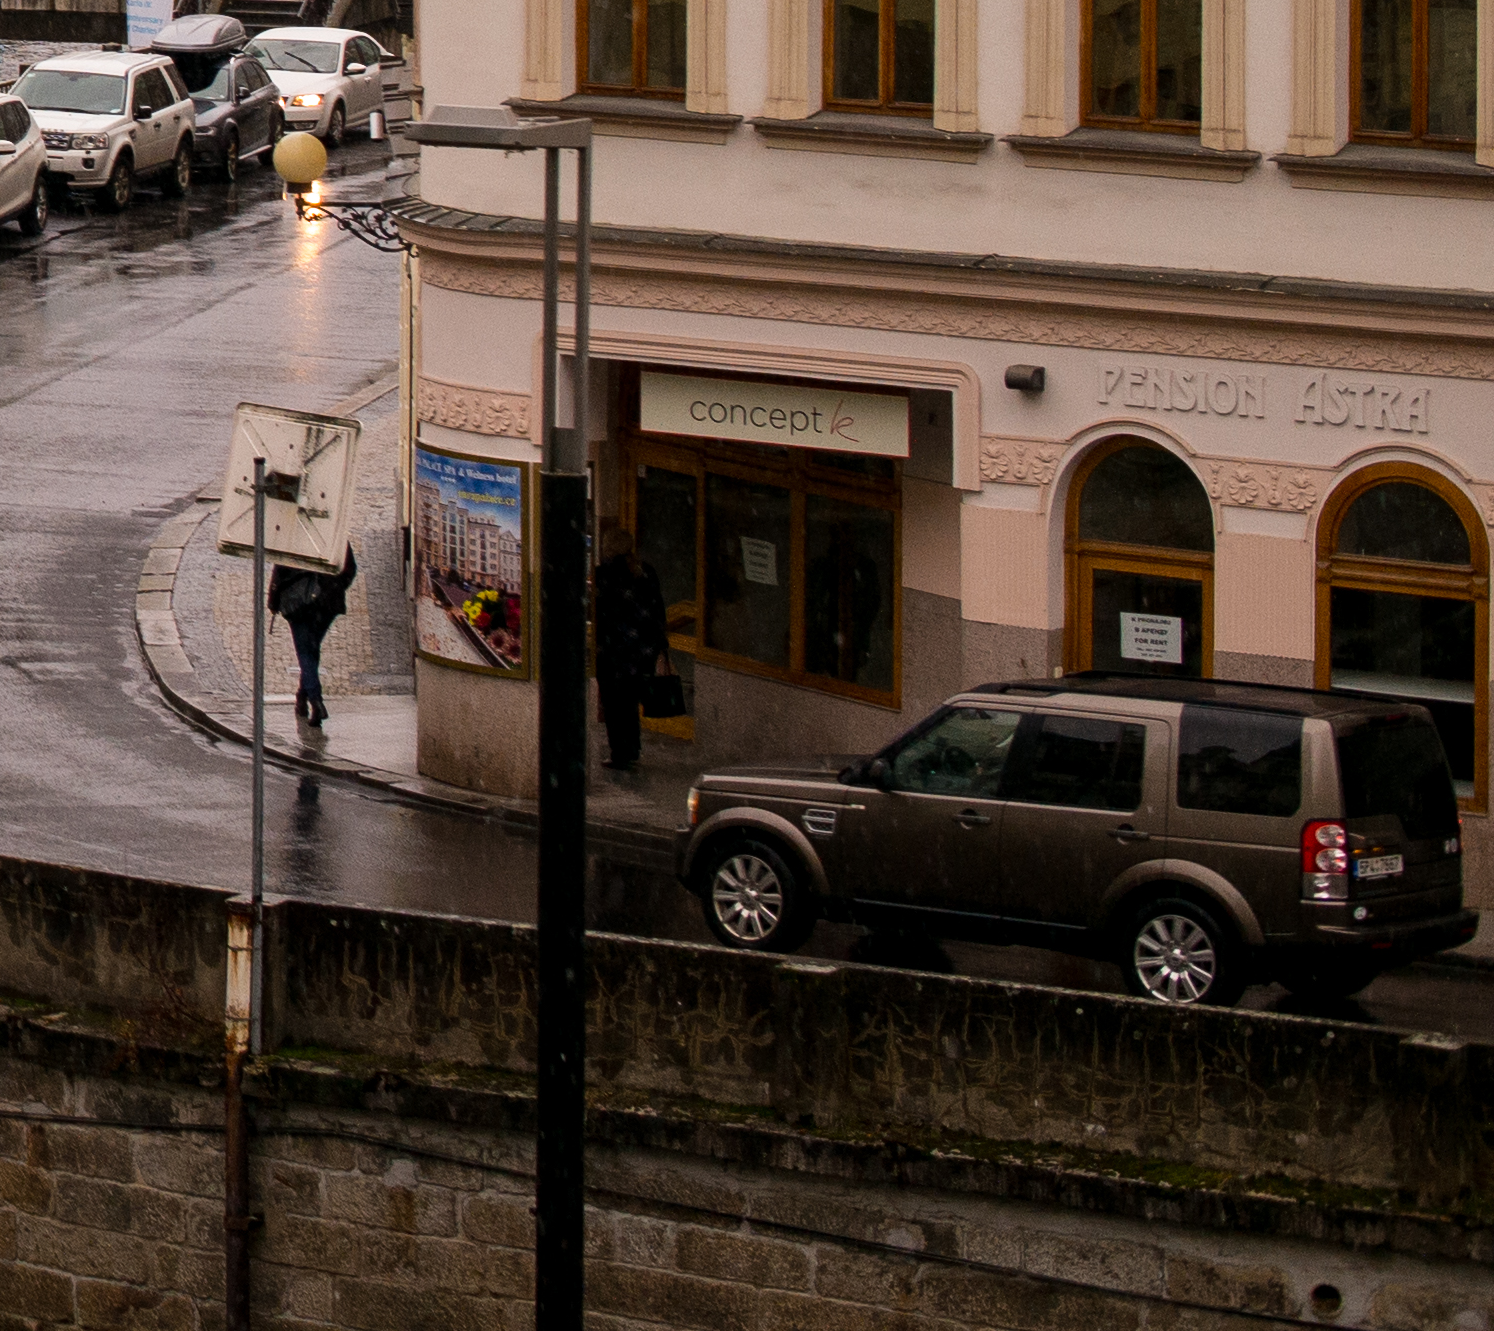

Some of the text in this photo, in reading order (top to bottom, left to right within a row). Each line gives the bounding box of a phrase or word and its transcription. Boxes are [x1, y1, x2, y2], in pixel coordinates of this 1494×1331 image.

[689, 399, 859, 442] concept k
[1096, 366, 1430, 433] PENSION ASTRA
[496, 473, 516, 484] hotel
